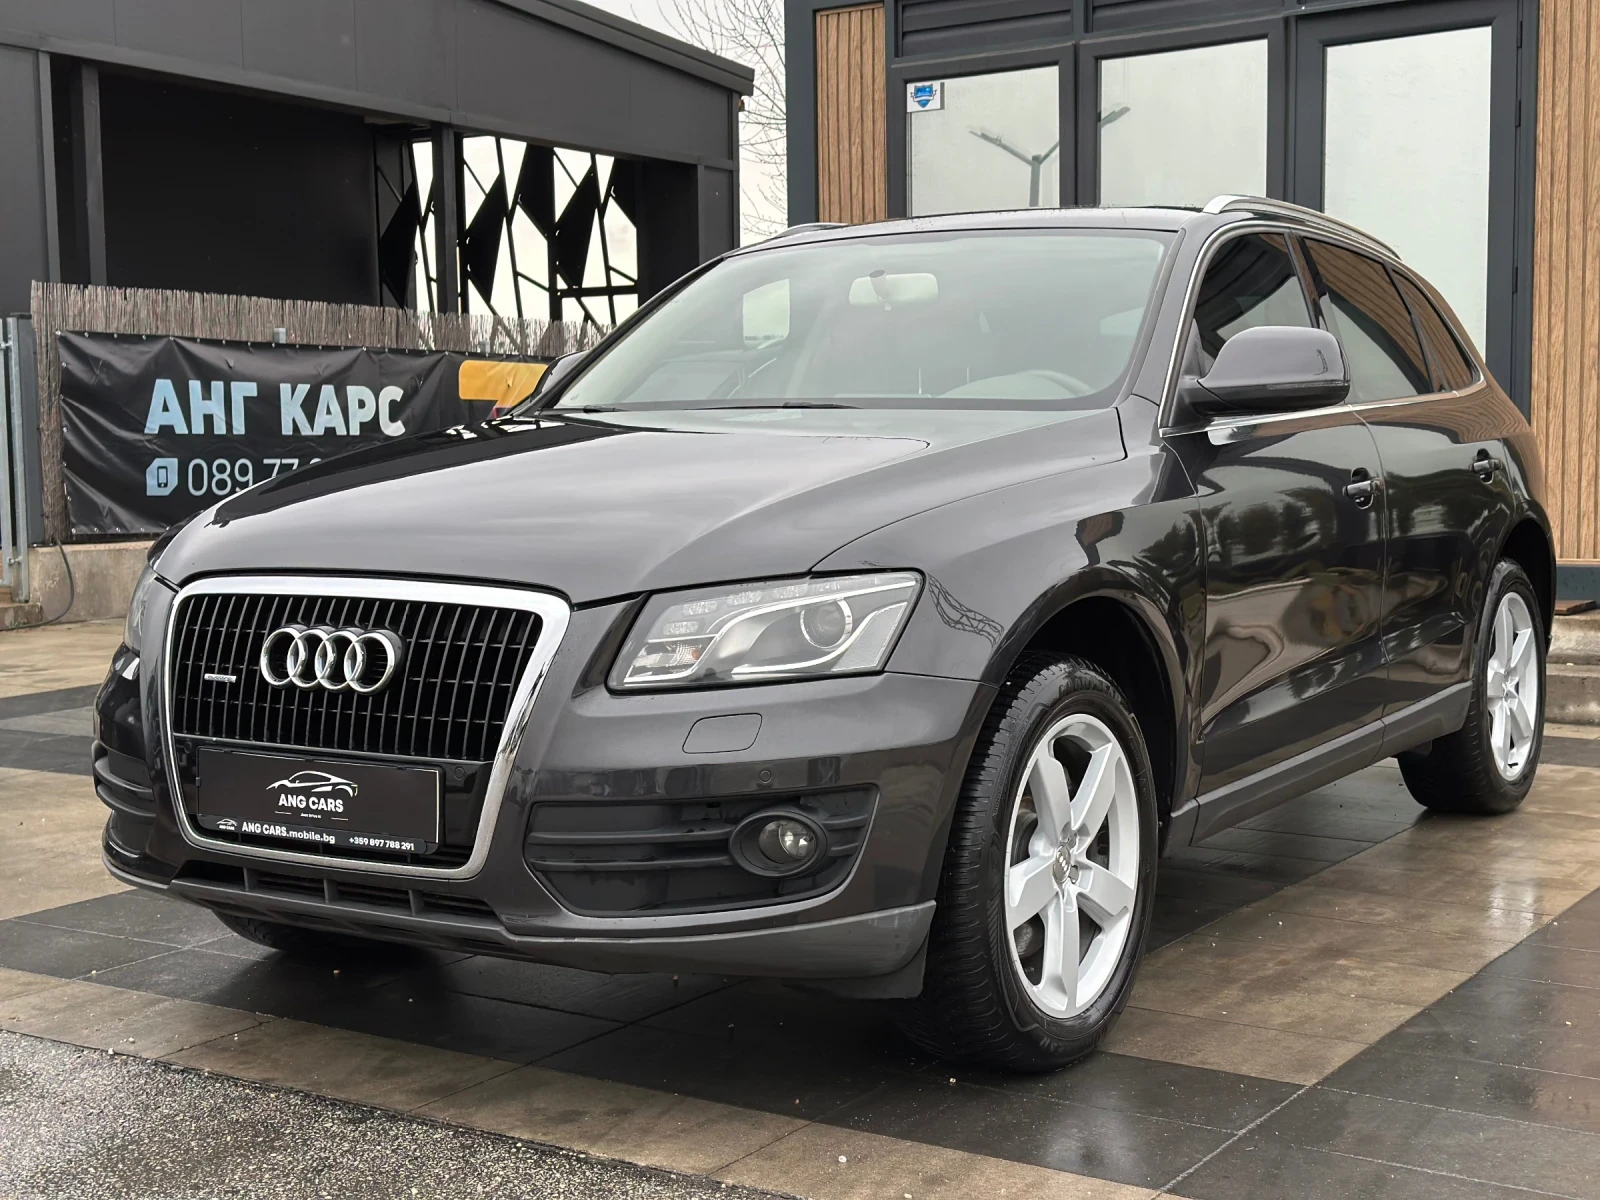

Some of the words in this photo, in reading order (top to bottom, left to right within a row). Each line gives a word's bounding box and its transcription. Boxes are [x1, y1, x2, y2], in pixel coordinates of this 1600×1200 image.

[144, 379, 257, 435] АНГ
[279, 383, 406, 437] КАРС
[187, 458, 254, 496] 089
[278, 793, 307, 809] ANG
[308, 796, 344, 813] CARS
[241, 821, 261, 834] ANG
[262, 824, 336, 844] CARS.mobile.bg
[348, 836, 369, 846] +359
[369, 838, 385, 847] 897
[385, 840, 401, 849] 788
[400, 841, 415, 851] 291
